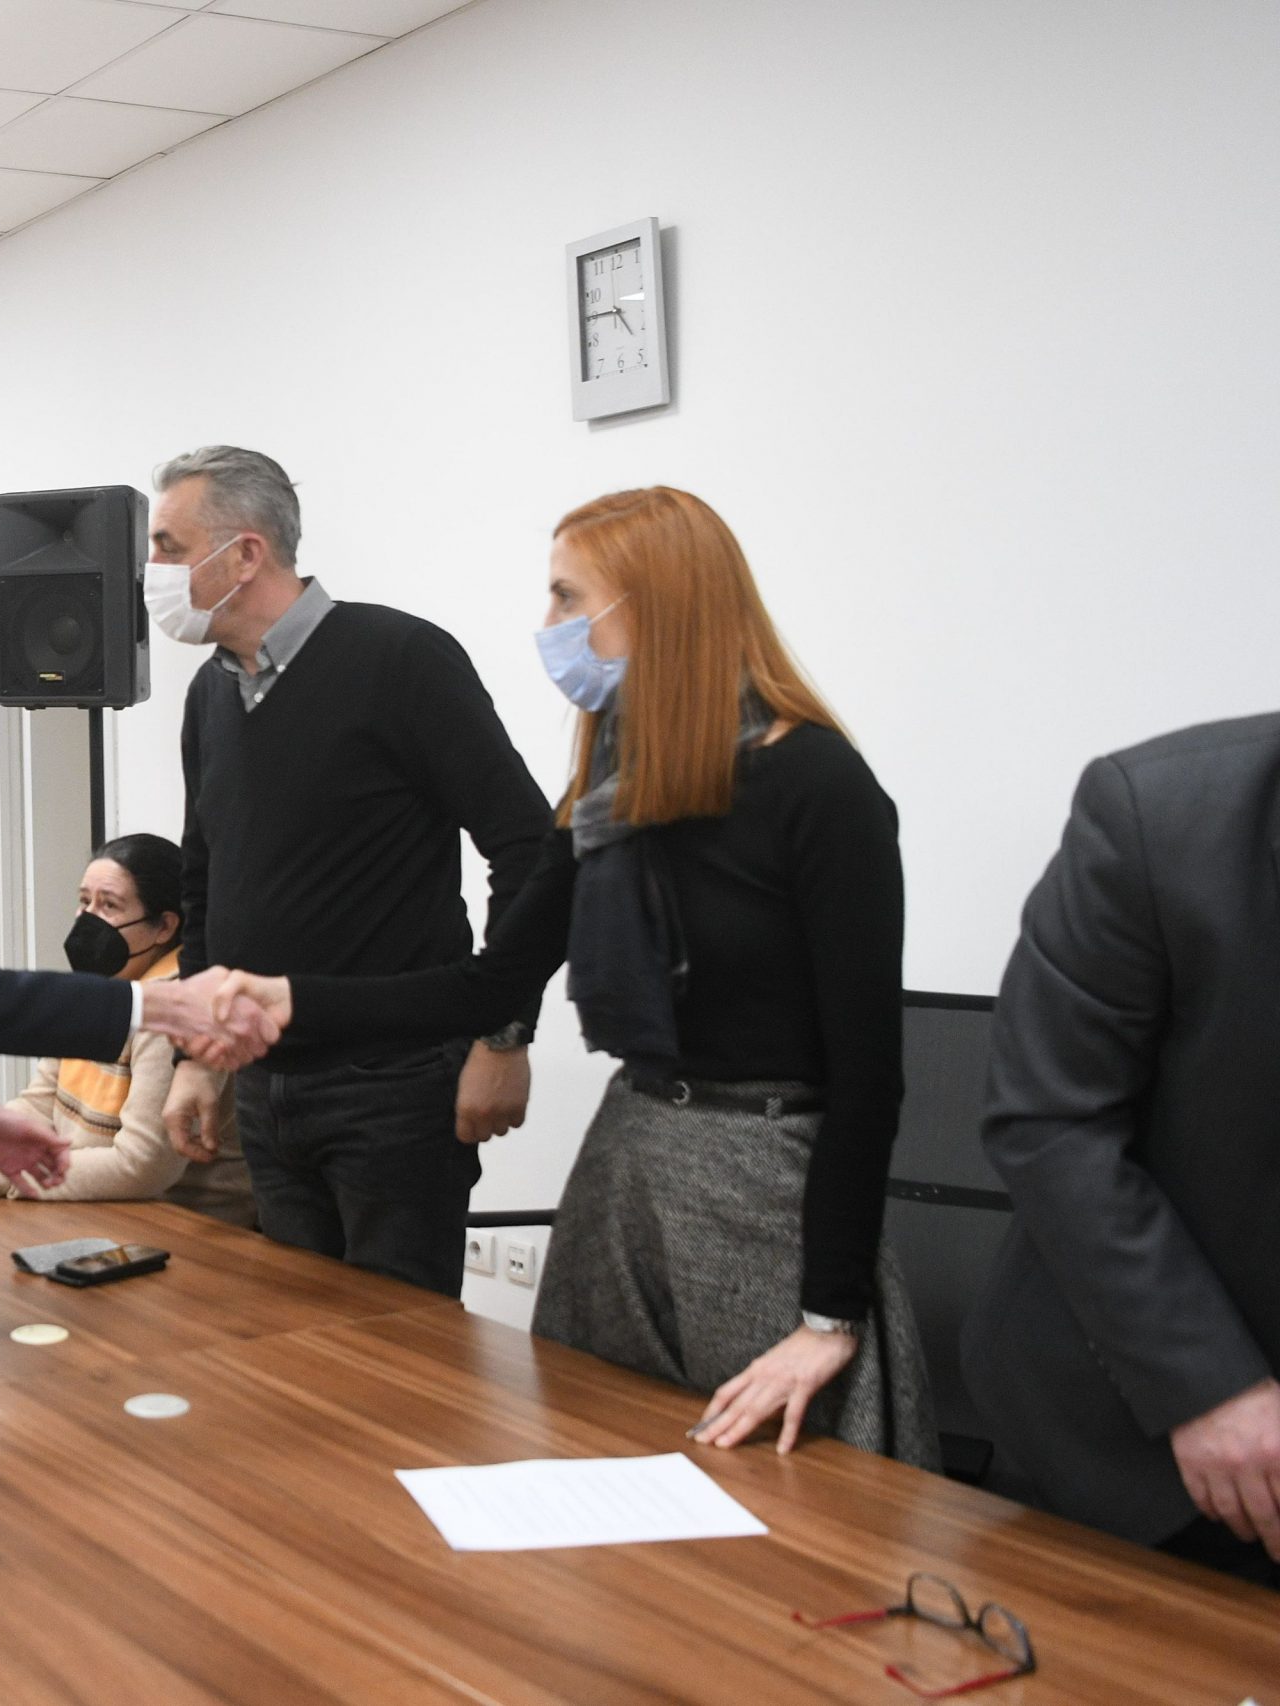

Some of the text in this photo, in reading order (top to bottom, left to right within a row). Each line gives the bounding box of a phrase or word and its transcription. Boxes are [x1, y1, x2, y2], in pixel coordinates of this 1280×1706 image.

[611, 253, 623, 271] 12
[590, 287, 601, 304] 10
[592, 332, 599, 348] 8
[617, 352, 624, 369] 6
